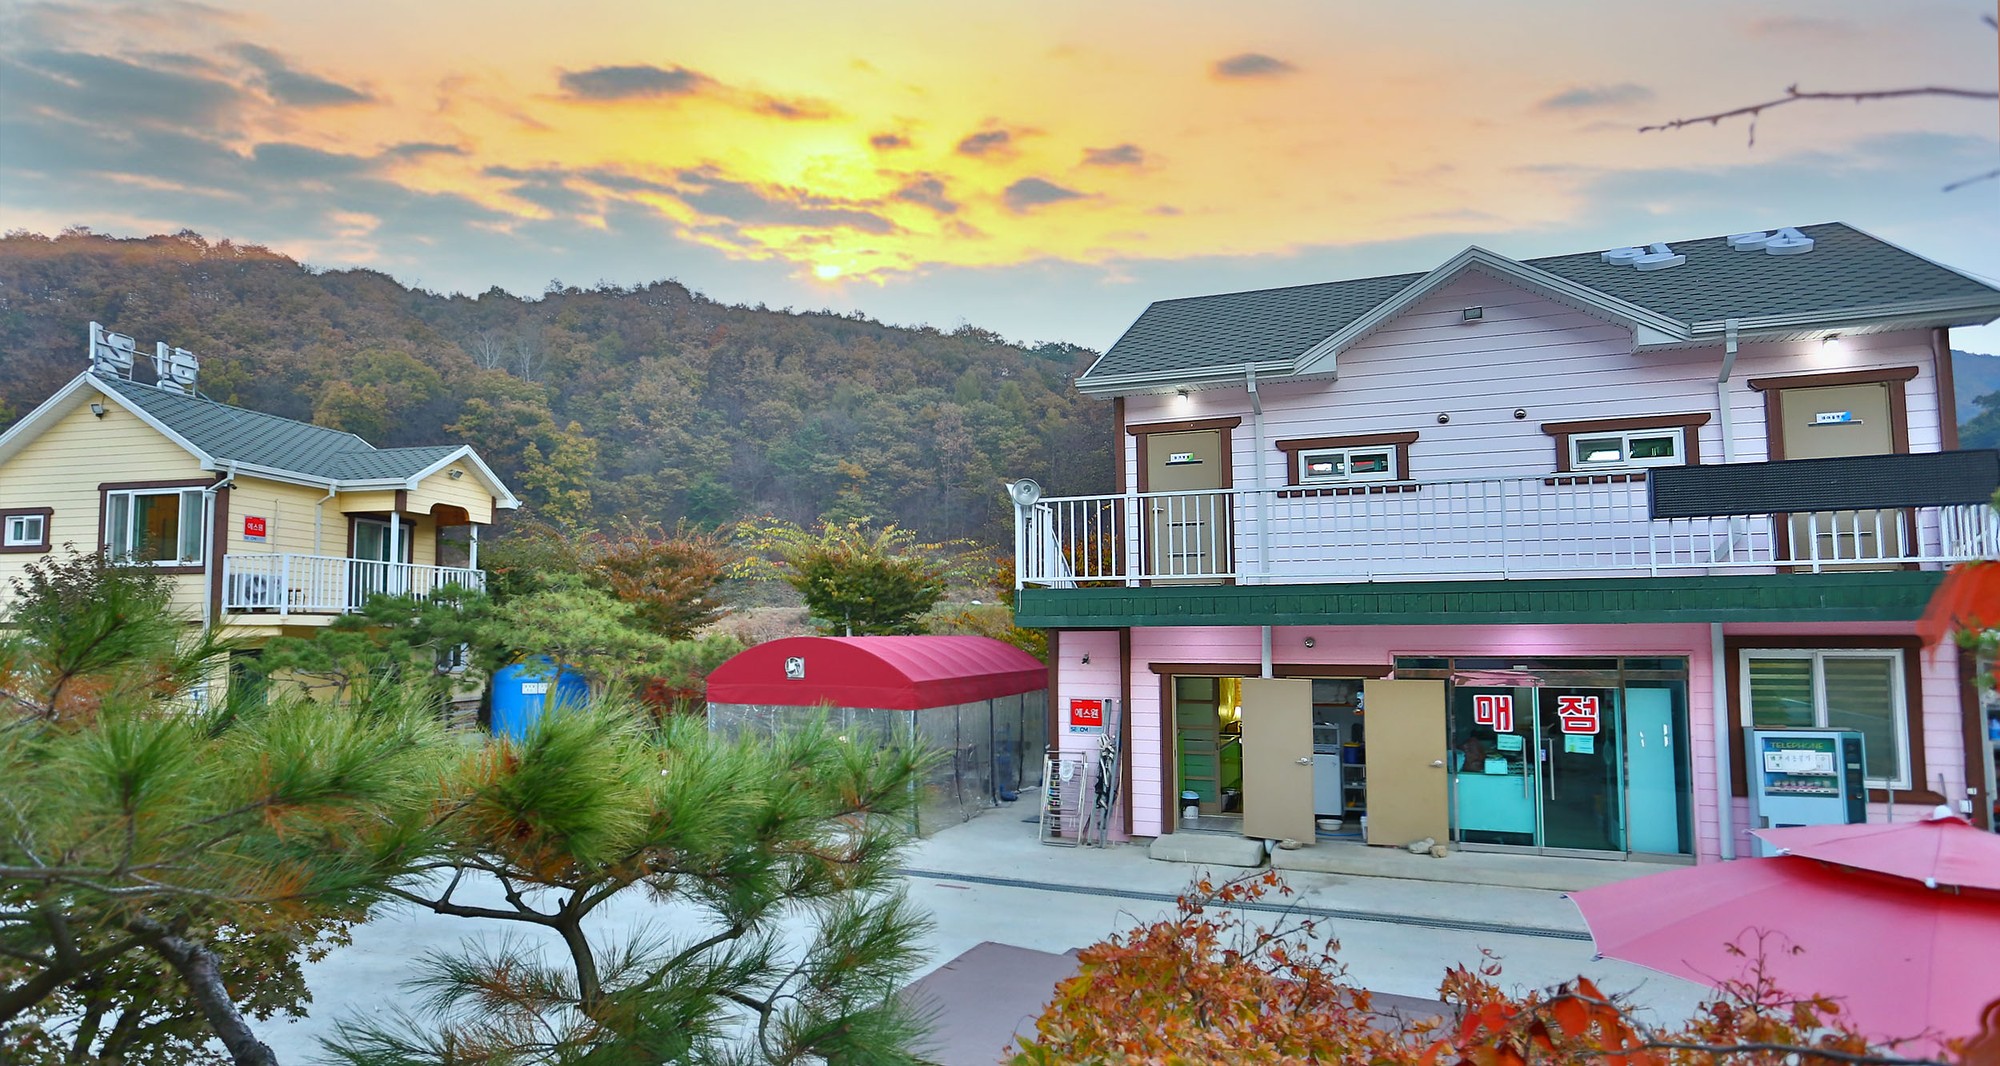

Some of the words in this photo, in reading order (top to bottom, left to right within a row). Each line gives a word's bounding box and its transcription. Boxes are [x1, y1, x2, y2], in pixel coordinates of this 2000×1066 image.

[1075, 708, 1099, 718] 에스원
[1473, 694, 1514, 733] 매
[1557, 695, 1600, 735] 점
[1771, 742, 1824, 750] TELEPHONE
